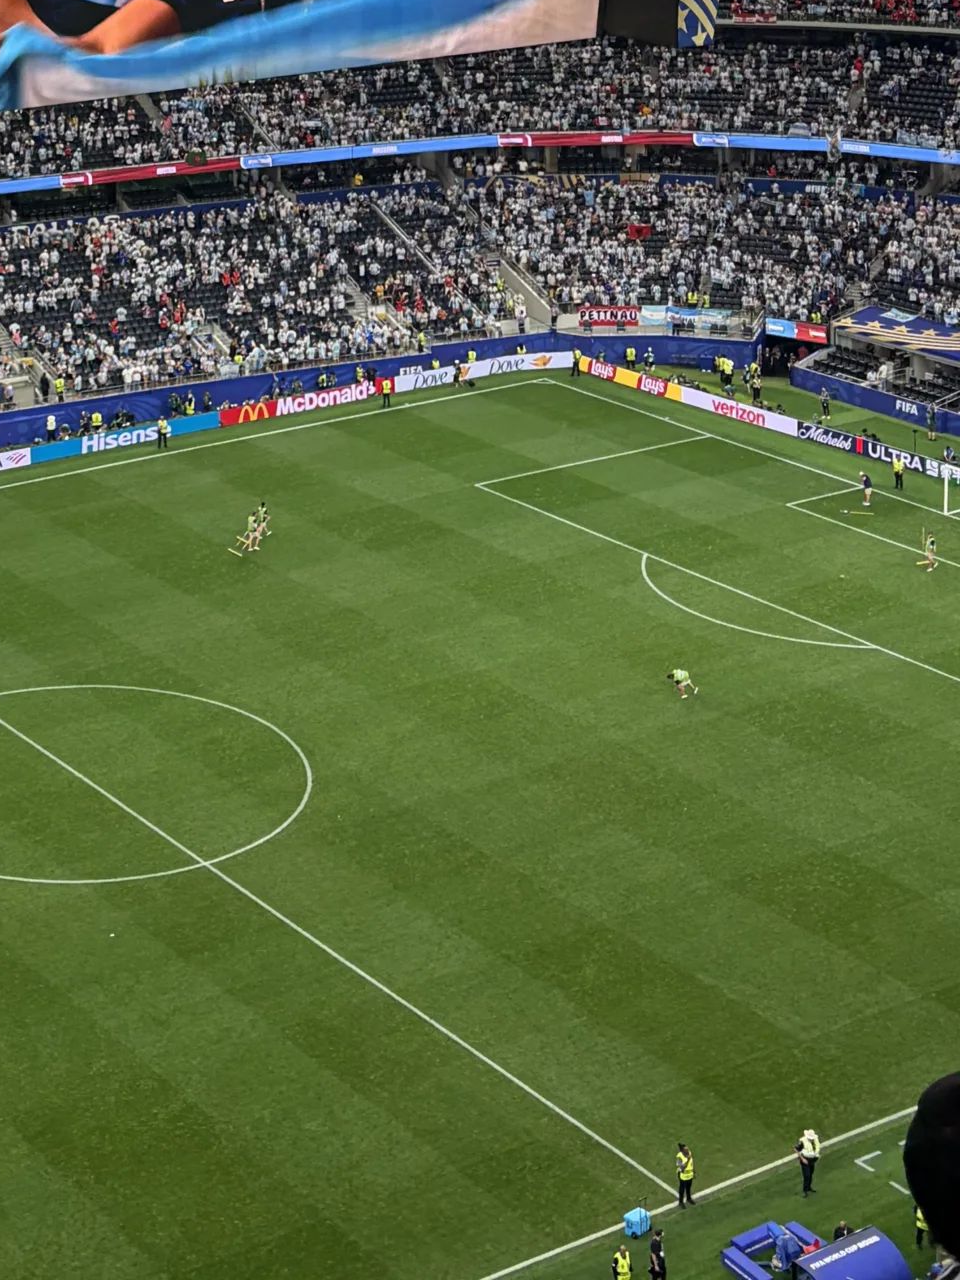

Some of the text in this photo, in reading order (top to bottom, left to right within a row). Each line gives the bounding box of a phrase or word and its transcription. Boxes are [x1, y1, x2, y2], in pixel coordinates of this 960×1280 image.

[580, 309, 638, 322] PETTNAU
[490, 357, 525, 376] Dove
[590, 359, 614, 379] Lay's
[413, 370, 448, 390] Dove
[640, 375, 666, 396] Lay's
[275, 378, 376, 417] McDonald's
[895, 399, 919, 416] FIFA
[711, 398, 766, 428] verizon
[798, 423, 924, 472] Michelob ULTRA
